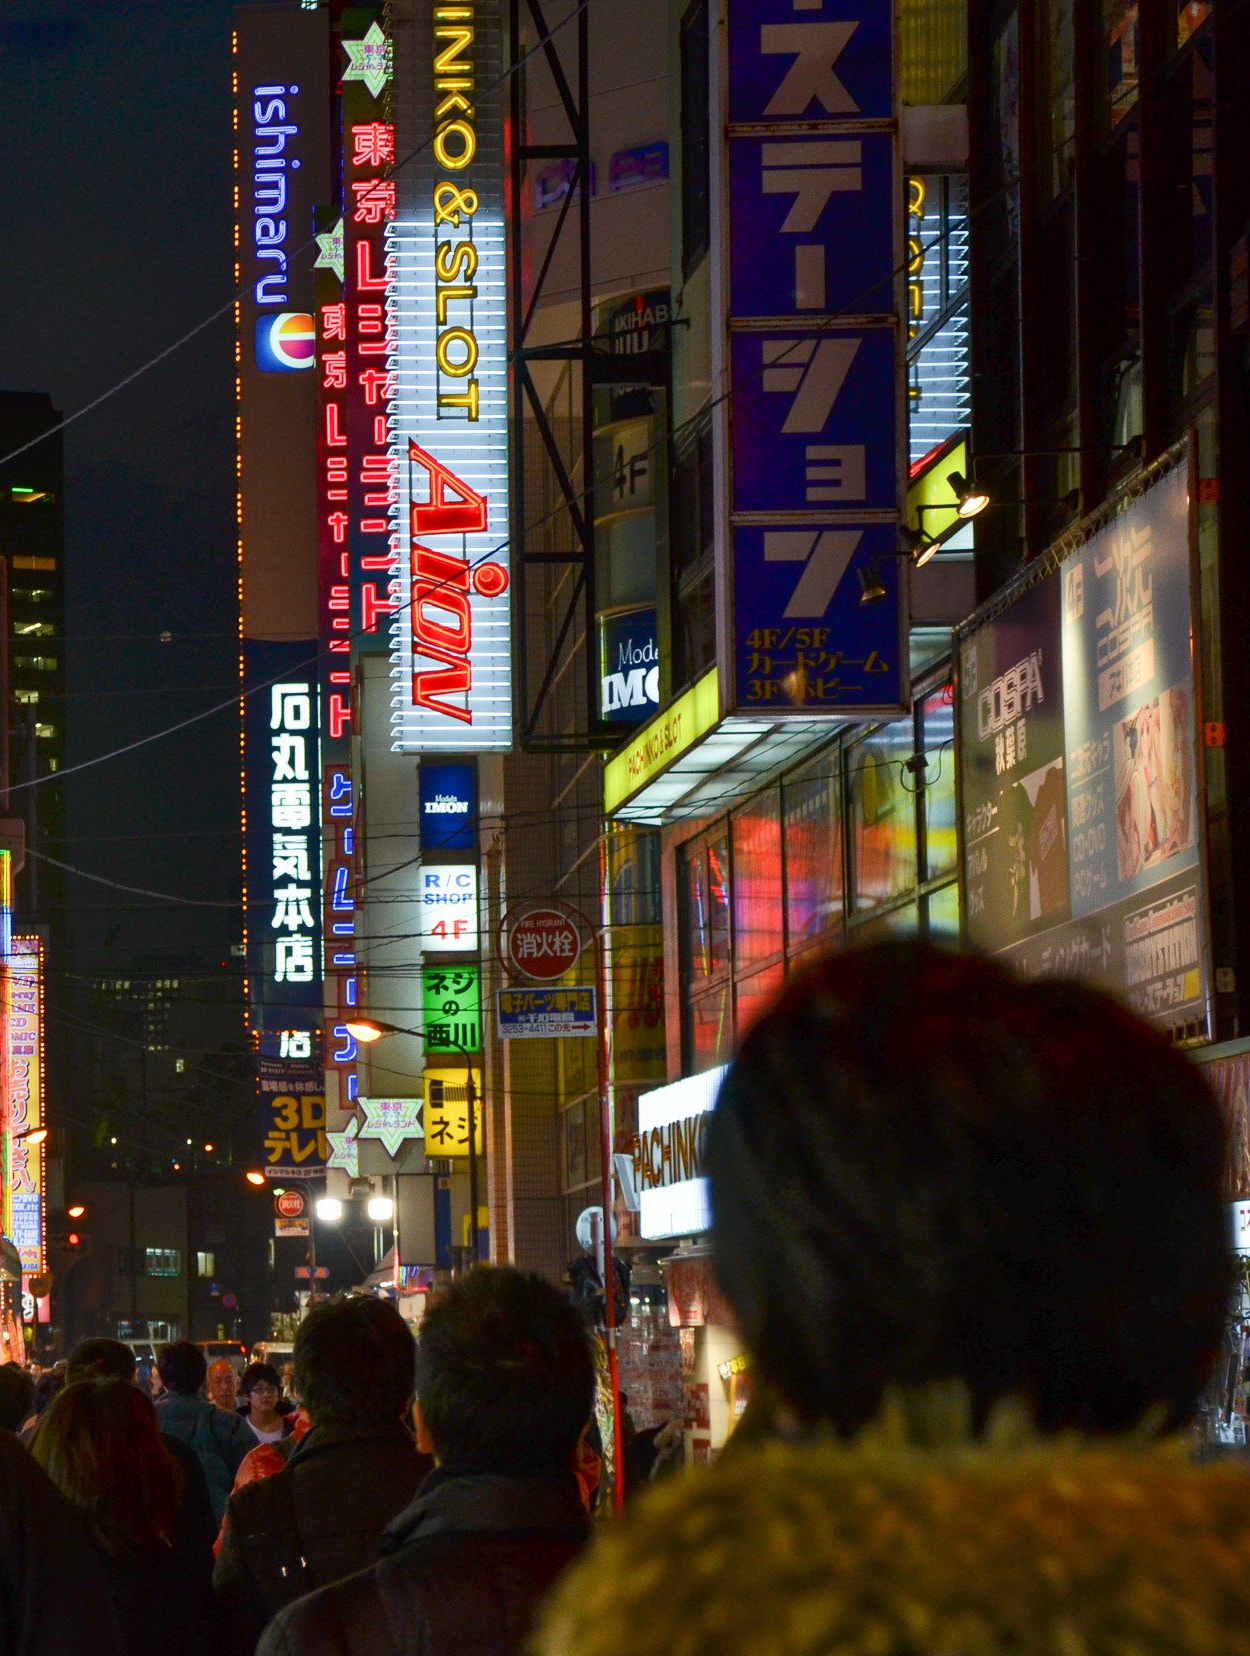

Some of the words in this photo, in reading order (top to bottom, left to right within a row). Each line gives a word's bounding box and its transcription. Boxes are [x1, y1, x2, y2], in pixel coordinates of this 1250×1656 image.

[254, 84, 301, 304] ishimaru
[760, 0, 868, 618] ステーション
[435, 240, 479, 424] SLOT
[746, 626, 831, 650] 4F/5F
[746, 650, 890, 674] カードゲーム
[977, 648, 1044, 742] COSPA
[424, 802, 469, 814] IMON
[269, 682, 314, 982] 石丸電気本店
[424, 893, 472, 906] SHOP
[431, 919, 469, 940] 4F
[516, 930, 574, 959] 消火栓
[426, 971, 475, 995] ネジ
[442, 1001, 460, 1017] の
[426, 1023, 477, 1049] 西川
[271, 1095, 327, 1130] 3D
[430, 1114, 478, 1146] ネジ
